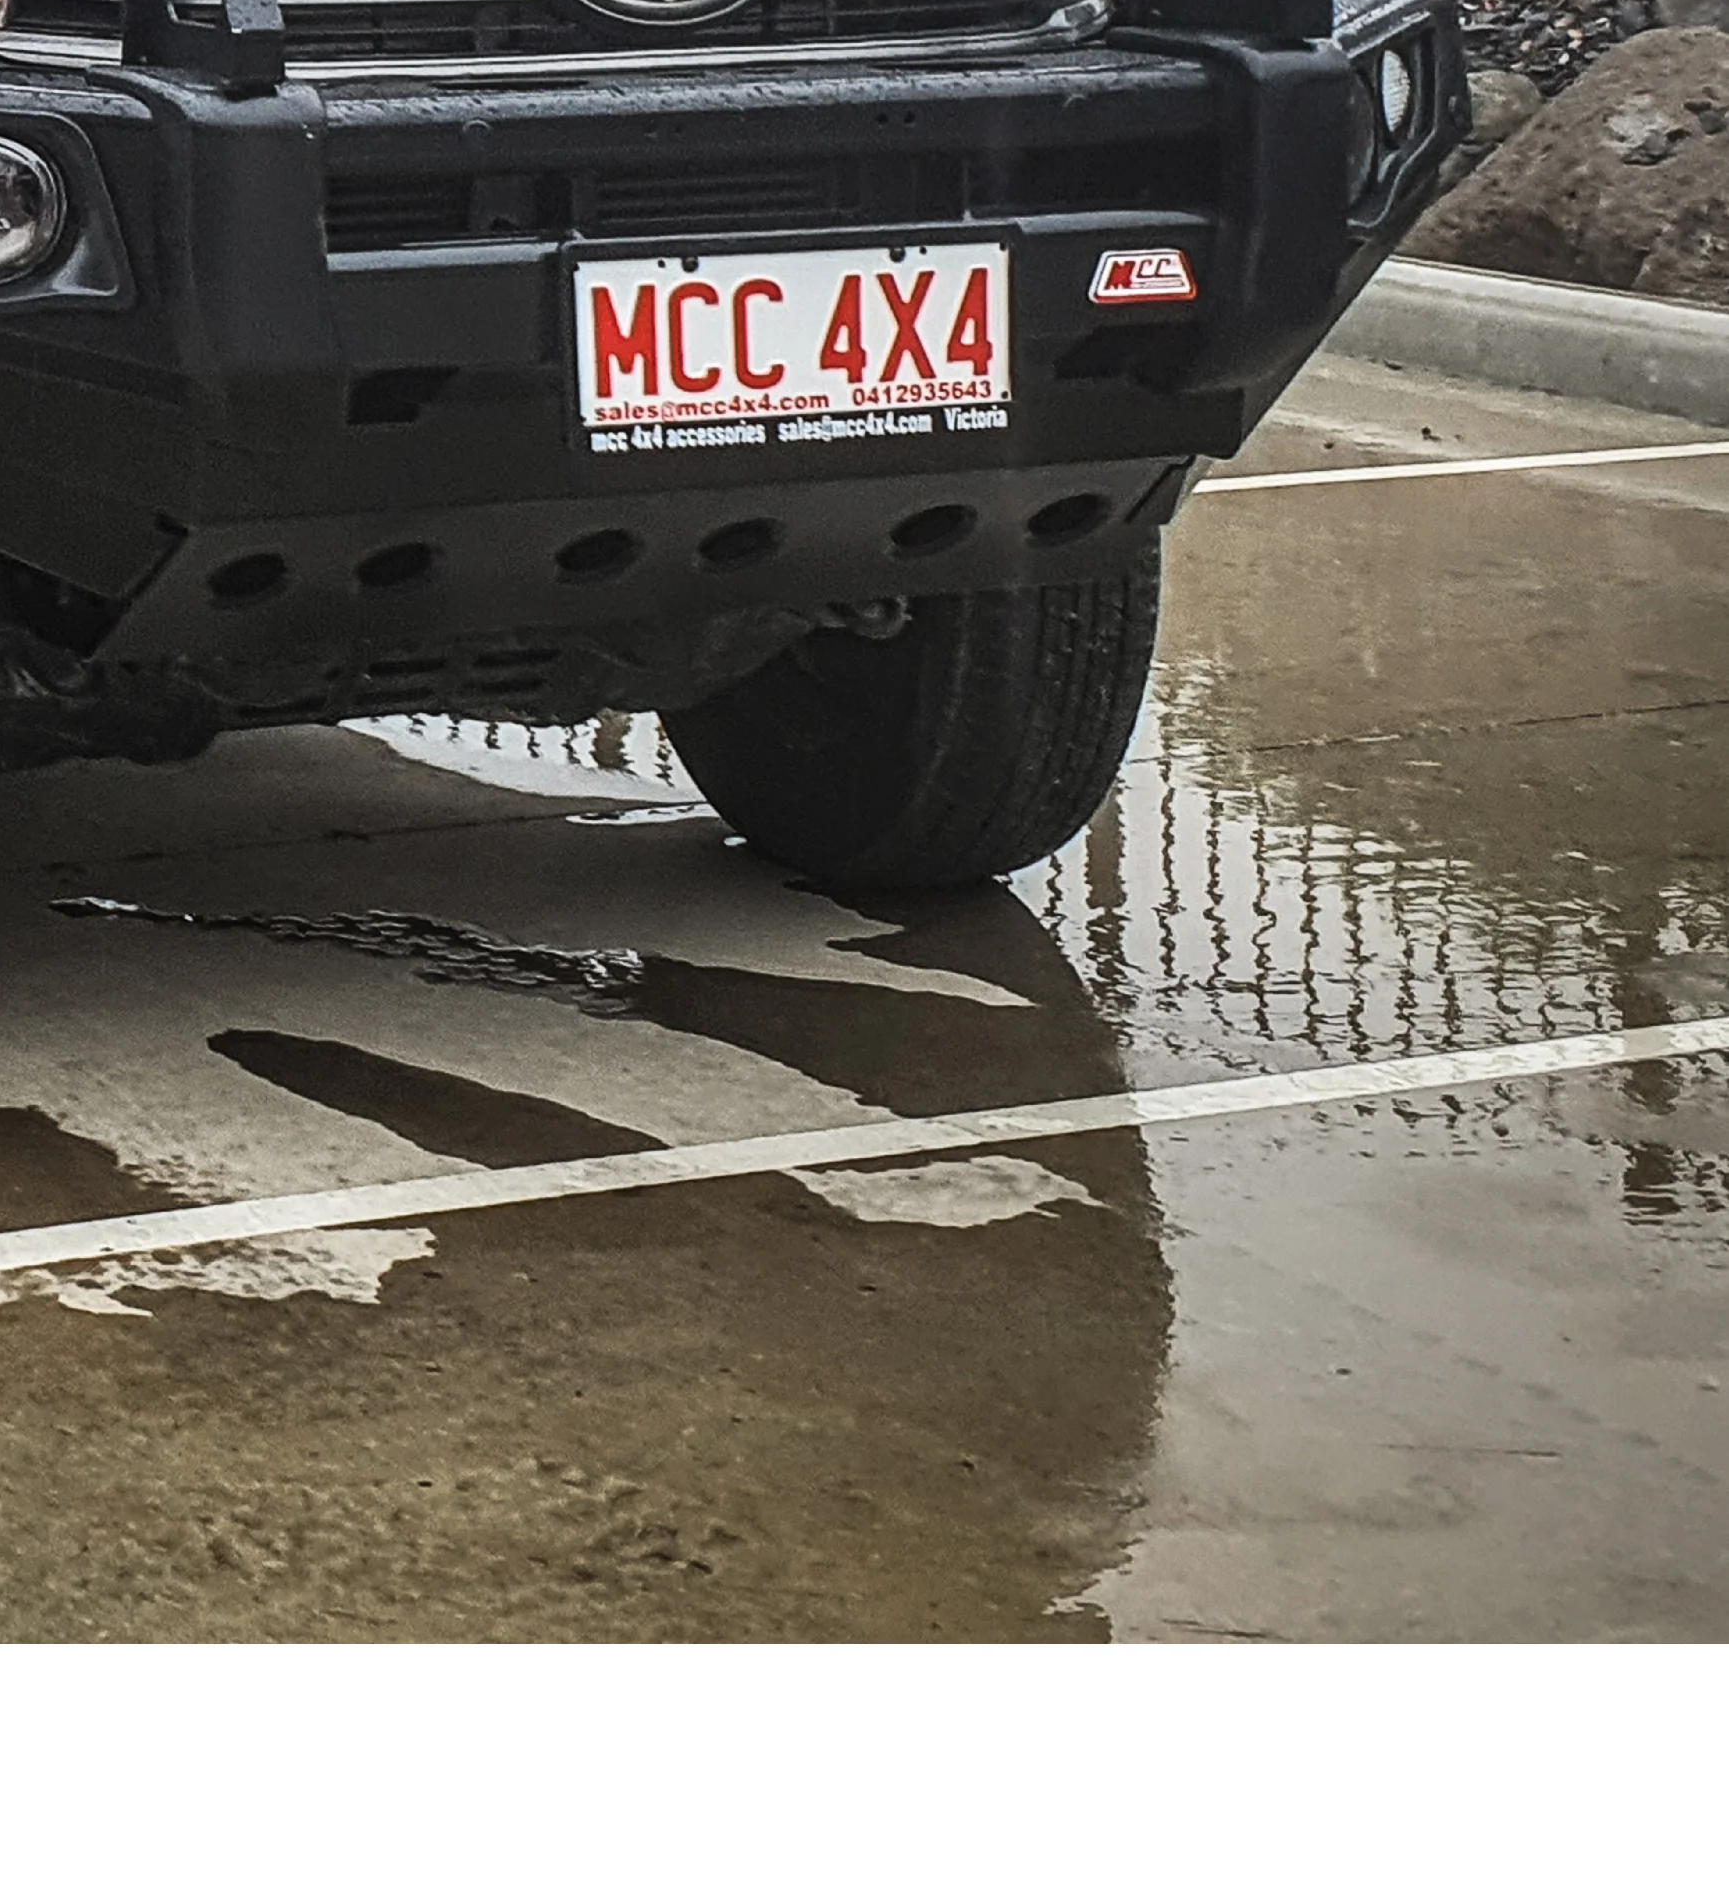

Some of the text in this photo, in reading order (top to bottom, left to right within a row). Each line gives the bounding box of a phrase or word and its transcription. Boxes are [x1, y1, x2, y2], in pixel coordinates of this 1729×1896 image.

[591, 267, 993, 398] MCC 4X4
[594, 380, 992, 422] sales@mcc4x4.com 0412935643
[591, 405, 1008, 452] mcc 4x4 accessories sales@mcc4x4.com Victoria
